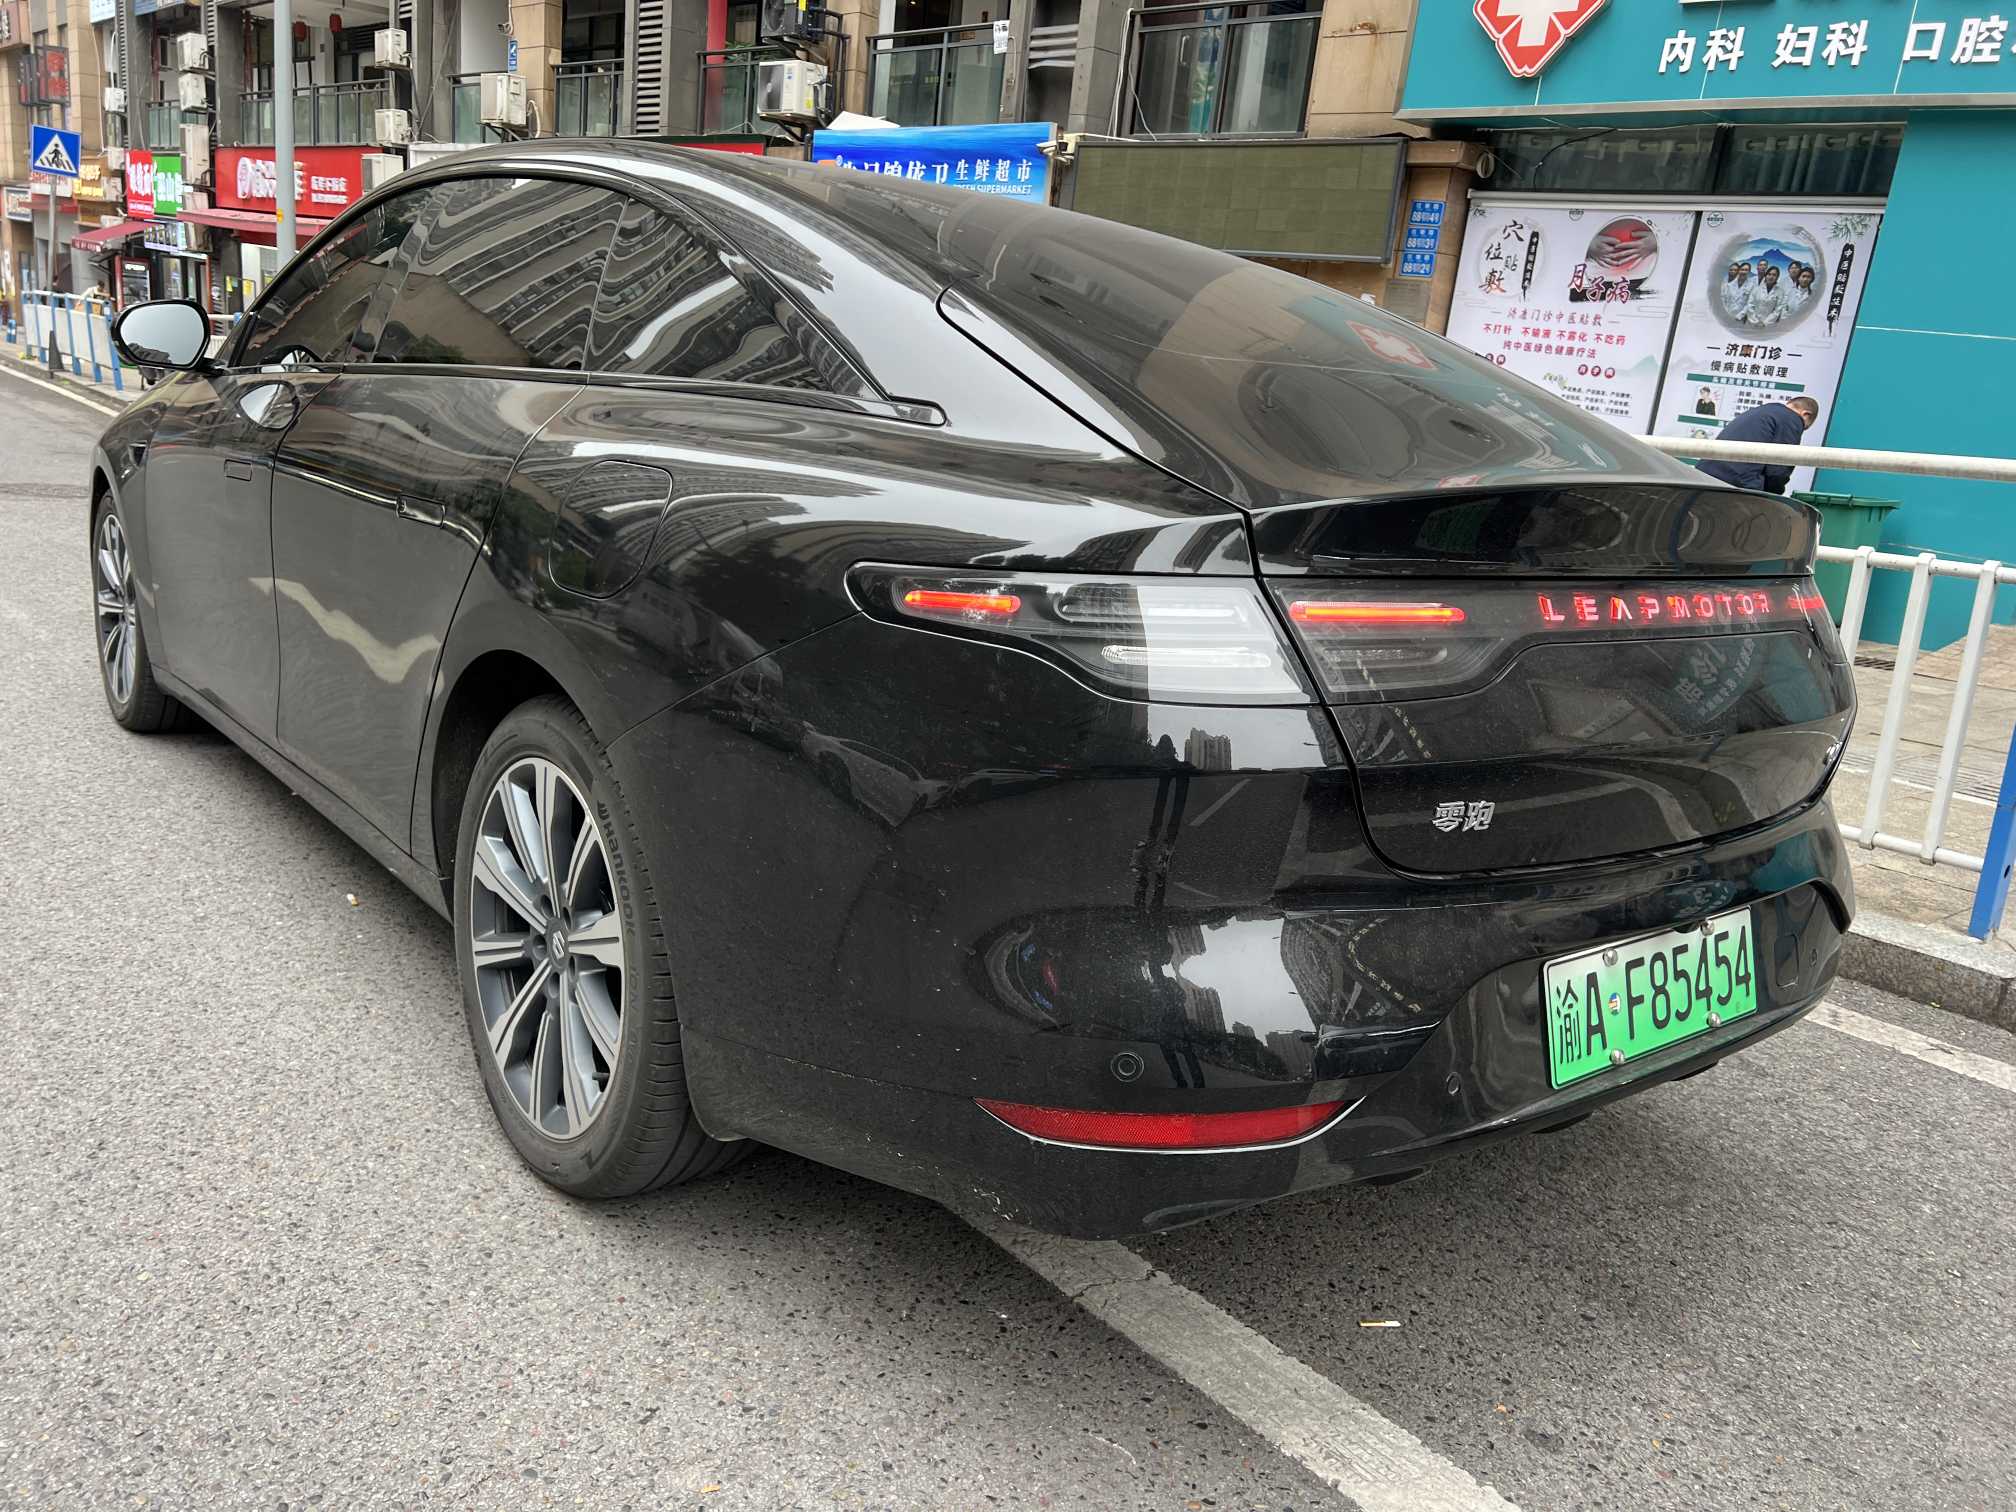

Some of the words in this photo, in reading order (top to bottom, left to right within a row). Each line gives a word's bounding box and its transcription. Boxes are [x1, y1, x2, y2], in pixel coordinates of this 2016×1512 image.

[1658, 26, 1746, 73] 内科
[1771, 20, 1869, 68] 妇科
[1902, 15, 2016, 64] 口腔
[955, 158, 1033, 183] 生鲜超市
[1568, 263, 1631, 304] 月子病
[1483, 323, 1512, 335] 不打针
[1593, 333, 1626, 346] 不吃药
[1725, 343, 1782, 360] 济康门诊
[1711, 360, 1789, 378] 慢病贴敷调理
[1540, 592, 1770, 622] LEAPMOTOR
[1432, 801, 1495, 832] 零跑
[1556, 971, 1607, 1064] 渝A
[1625, 925, 1752, 1041] F85454
